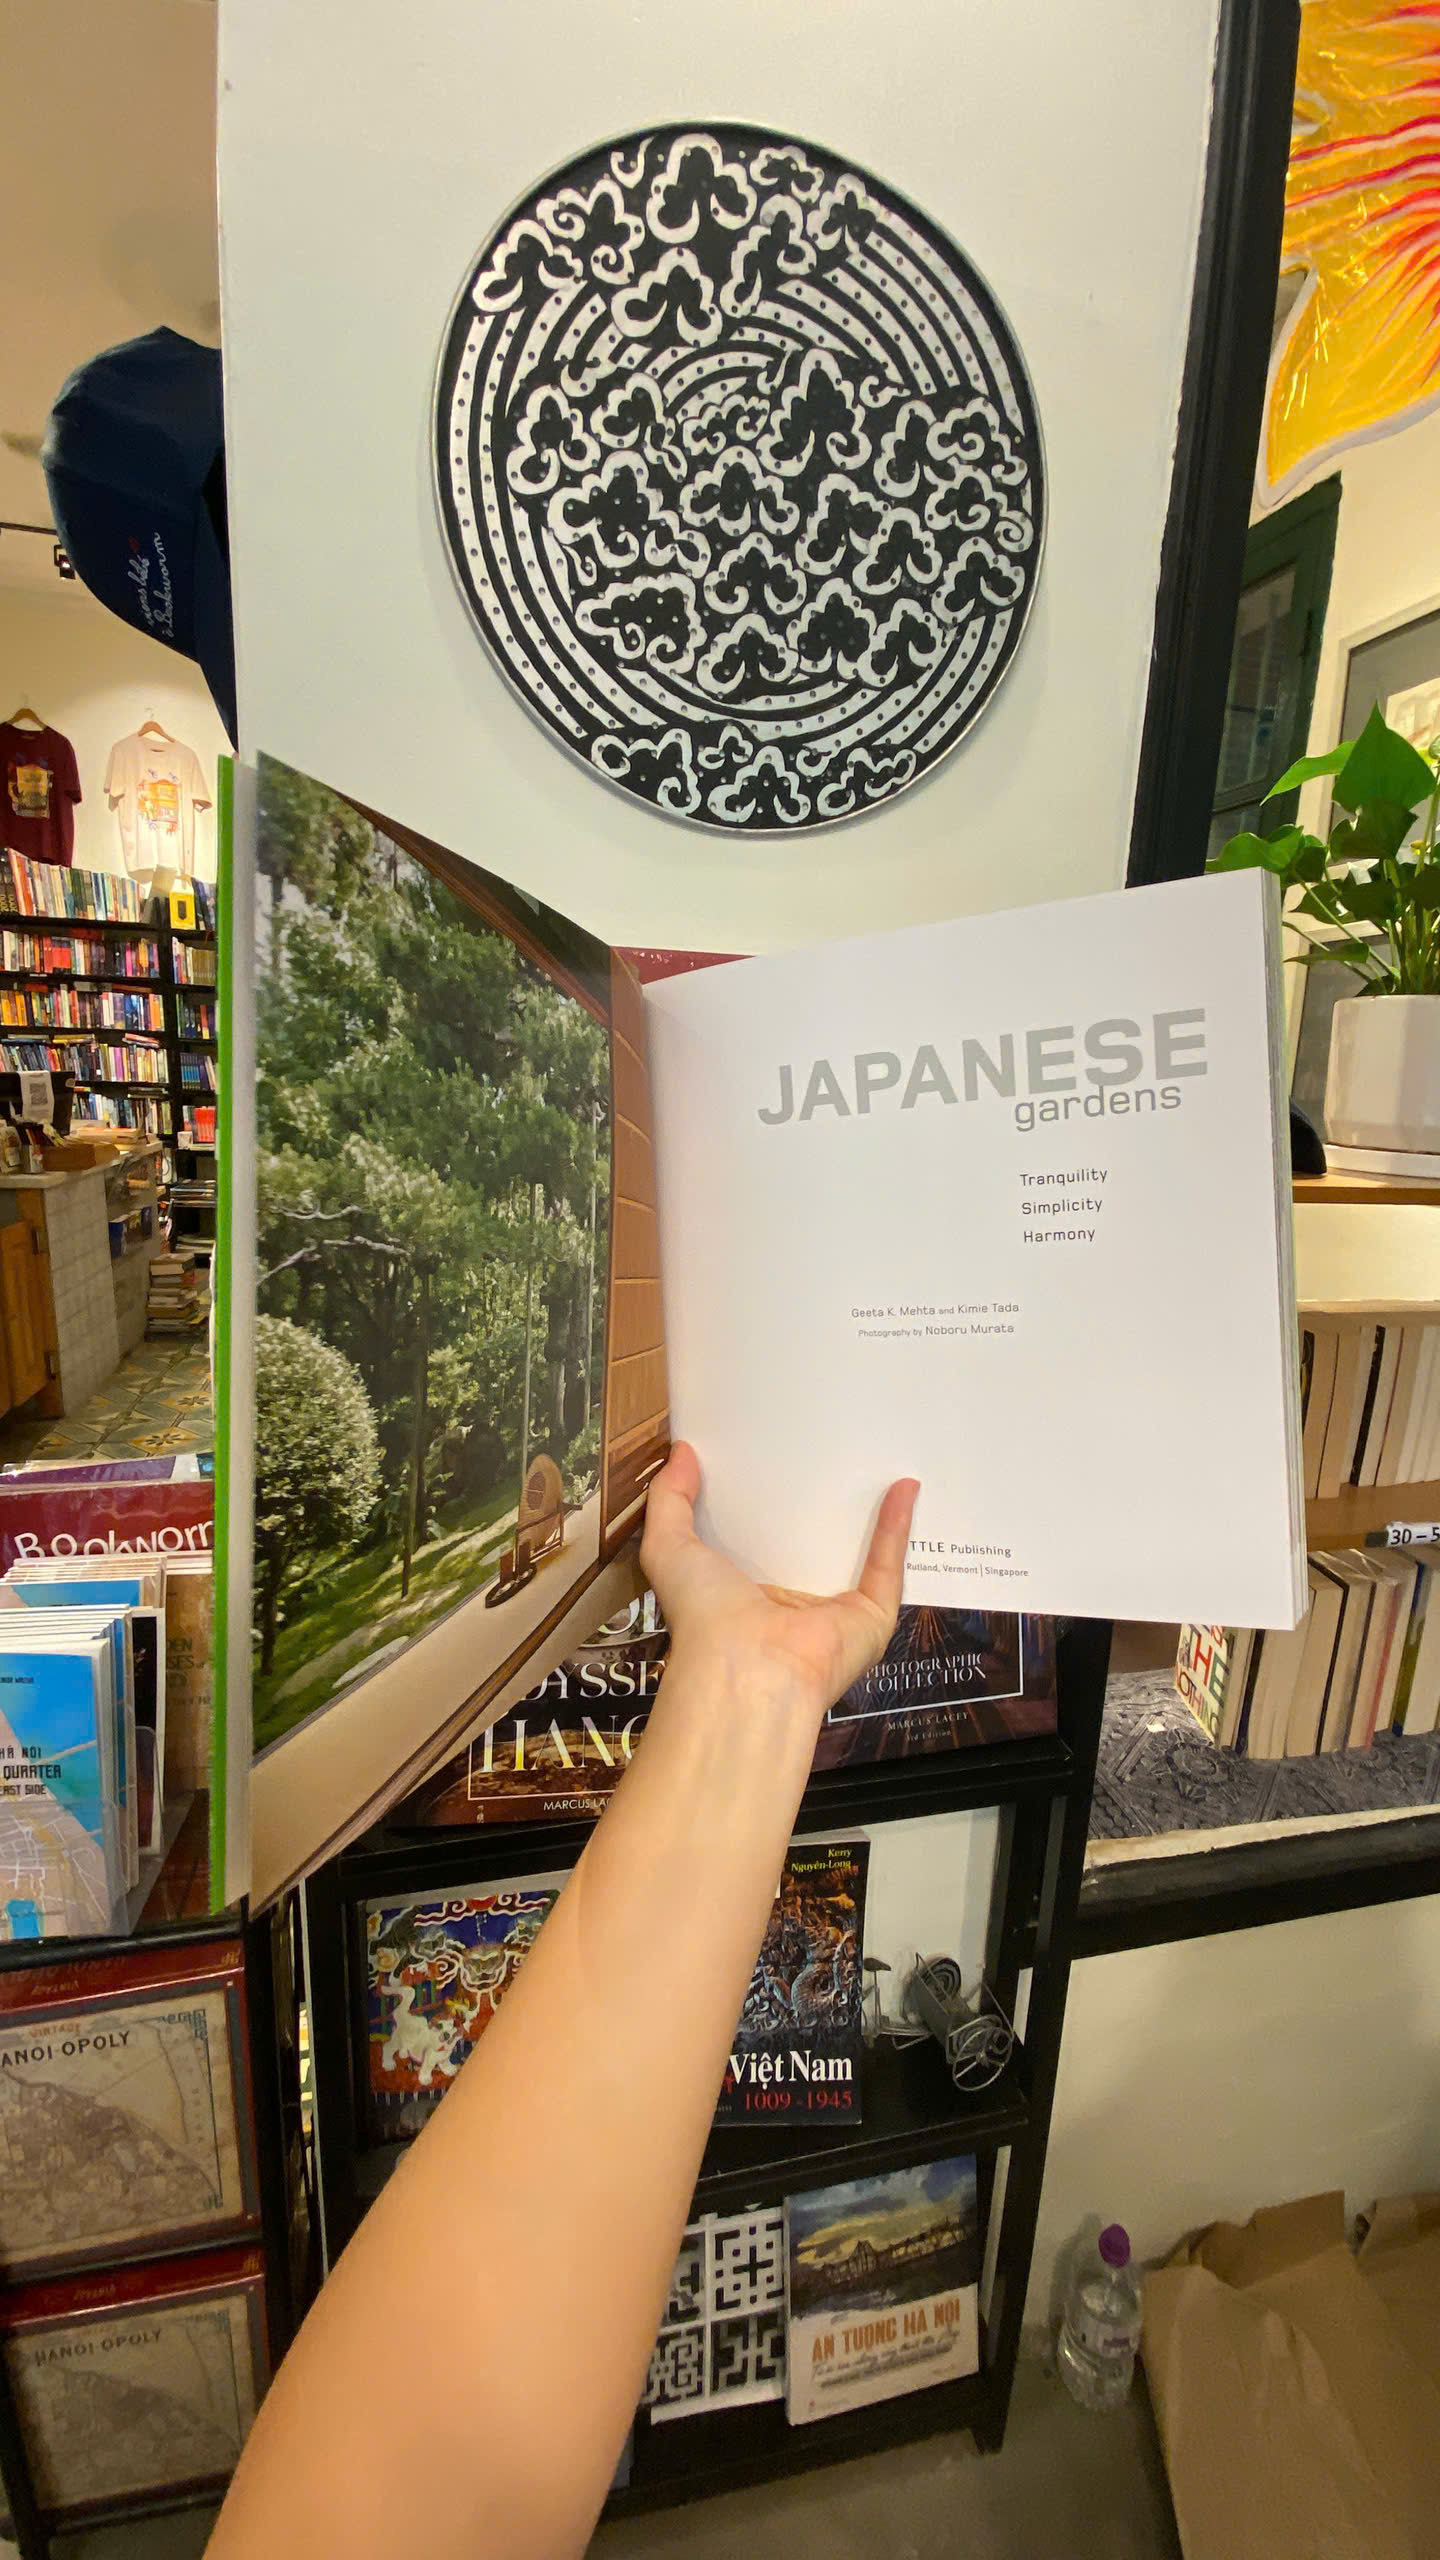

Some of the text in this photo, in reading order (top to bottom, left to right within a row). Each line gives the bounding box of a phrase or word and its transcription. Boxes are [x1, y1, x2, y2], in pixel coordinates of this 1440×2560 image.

[757, 1008, 1208, 1126] JAPANESE
[1014, 1085, 1182, 1132] gardens
[1019, 1168, 1108, 1187] Tranquility
[1021, 1198, 1103, 1216] Simplicity
[1023, 1229, 1096, 1243] Harmony
[851, 1307, 884, 1318] Geeta
[900, 1305, 936, 1316] Mehta
[938, 1306, 955, 1315] and
[957, 1303, 988, 1314] Kimie
[992, 1302, 1019, 1313] Tada
[858, 1323, 1014, 1338] Photography by Noboru Murata
[1391, 1528, 1412, 1545] 30
[950, 1543, 1012, 1558] Publishing
[943, 1563, 978, 1575] Vermont
[985, 1566, 1029, 1577] Singapore
[866, 1652, 982, 1679] PHOTOGRAPHIC
[866, 1666, 986, 1694] COLLECTION
[887, 1711, 969, 1731] MARCUS LACEY
[543, 1799, 590, 1811] MARCUS
[828, 1848, 853, 1858] Kerry
[61, 2030, 130, 2057] OPOLY
[729, 2052, 785, 2090] Việt
[788, 2050, 853, 2082] Nam
[744, 2091, 792, 2111] 1009
[807, 2090, 852, 2110] 1945
[102, 2328, 162, 2352] OPOLY
